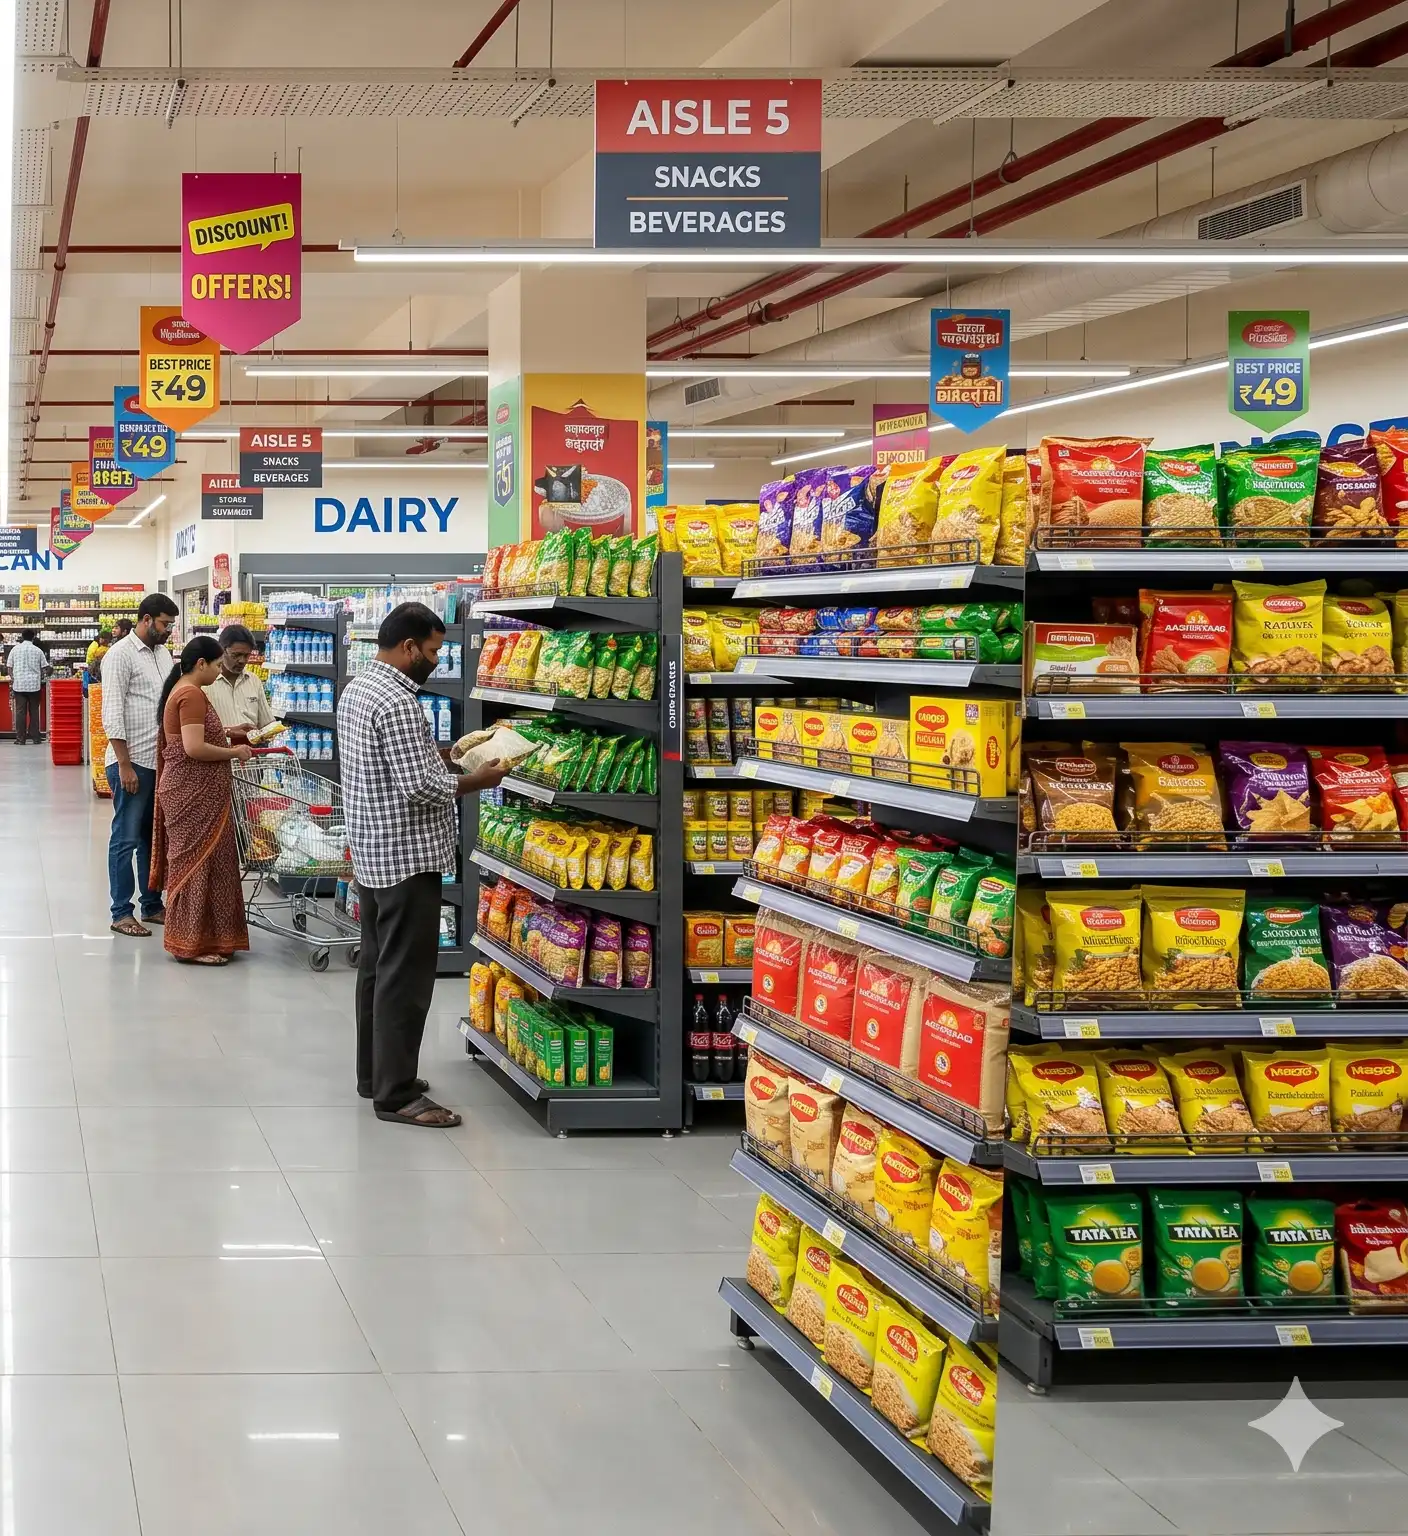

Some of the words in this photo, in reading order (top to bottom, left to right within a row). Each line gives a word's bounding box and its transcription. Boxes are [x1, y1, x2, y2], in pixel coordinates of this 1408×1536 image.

[626, 99, 752, 135] AISLE
[765, 99, 790, 135] 5
[654, 165, 761, 188] SNACKS
[195, 213, 289, 246] DISCOUNT!
[629, 211, 786, 233] BEVERAGES
[191, 273, 291, 300] OFFERS!
[150, 359, 178, 370] BEST
[179, 359, 211, 370] PRICE
[1236, 363, 1266, 374] BEST
[1268, 363, 1301, 374] PRICE
[151, 375, 206, 401] ₹49
[1239, 377, 1297, 406] ₹49
[251, 434, 296, 448] AISLE
[301, 434, 312, 448] 5
[263, 457, 299, 466] SNACKS
[253, 473, 309, 483] BEVERAGES
[314, 497, 459, 533] DAIRY
[1070, 1228, 1111, 1241] TATA
[1111, 1227, 1137, 1239] TEA
[1174, 1226, 1213, 1239] TATA
[1213, 1226, 1238, 1238] TEA
[1270, 1229, 1308, 1243] TATA
[1308, 1228, 1332, 1241] TEA
